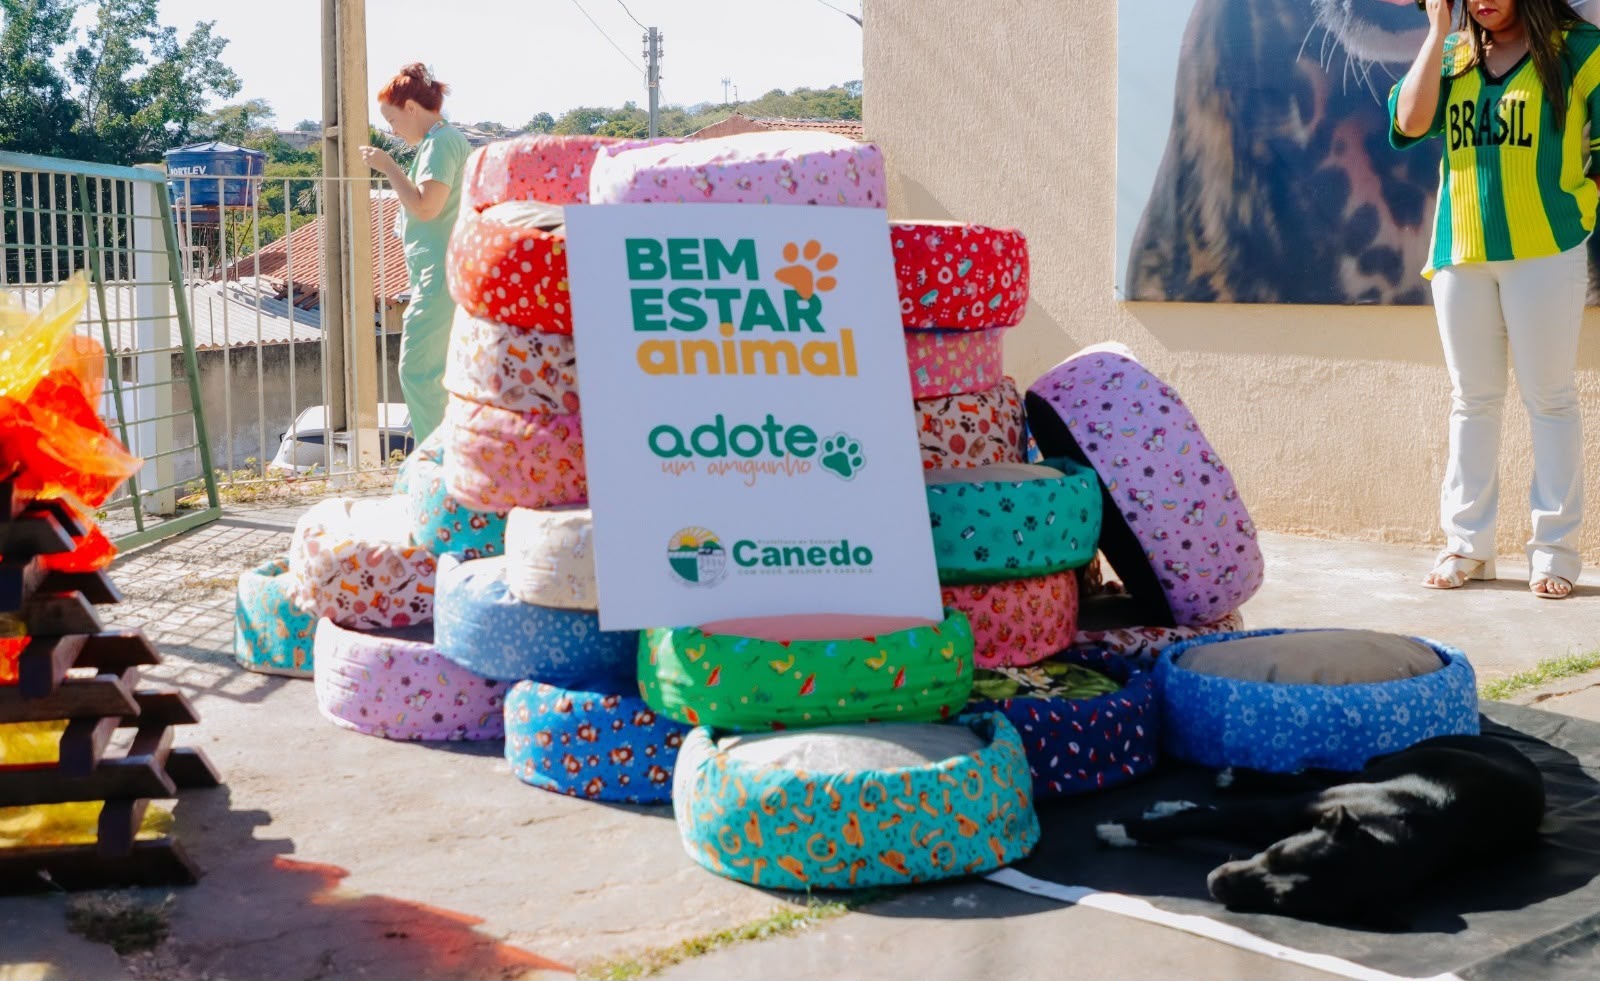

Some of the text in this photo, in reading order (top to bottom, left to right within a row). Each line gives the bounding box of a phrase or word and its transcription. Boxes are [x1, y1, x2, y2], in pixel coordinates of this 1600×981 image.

[1449, 97, 1533, 152] BRASIL
[625, 238, 759, 280] BEM
[630, 287, 826, 333] ESTAR
[636, 322, 858, 377] animal
[648, 414, 818, 458] adote
[661, 451, 812, 487] um amiguinho
[732, 539, 873, 567] Canedo
